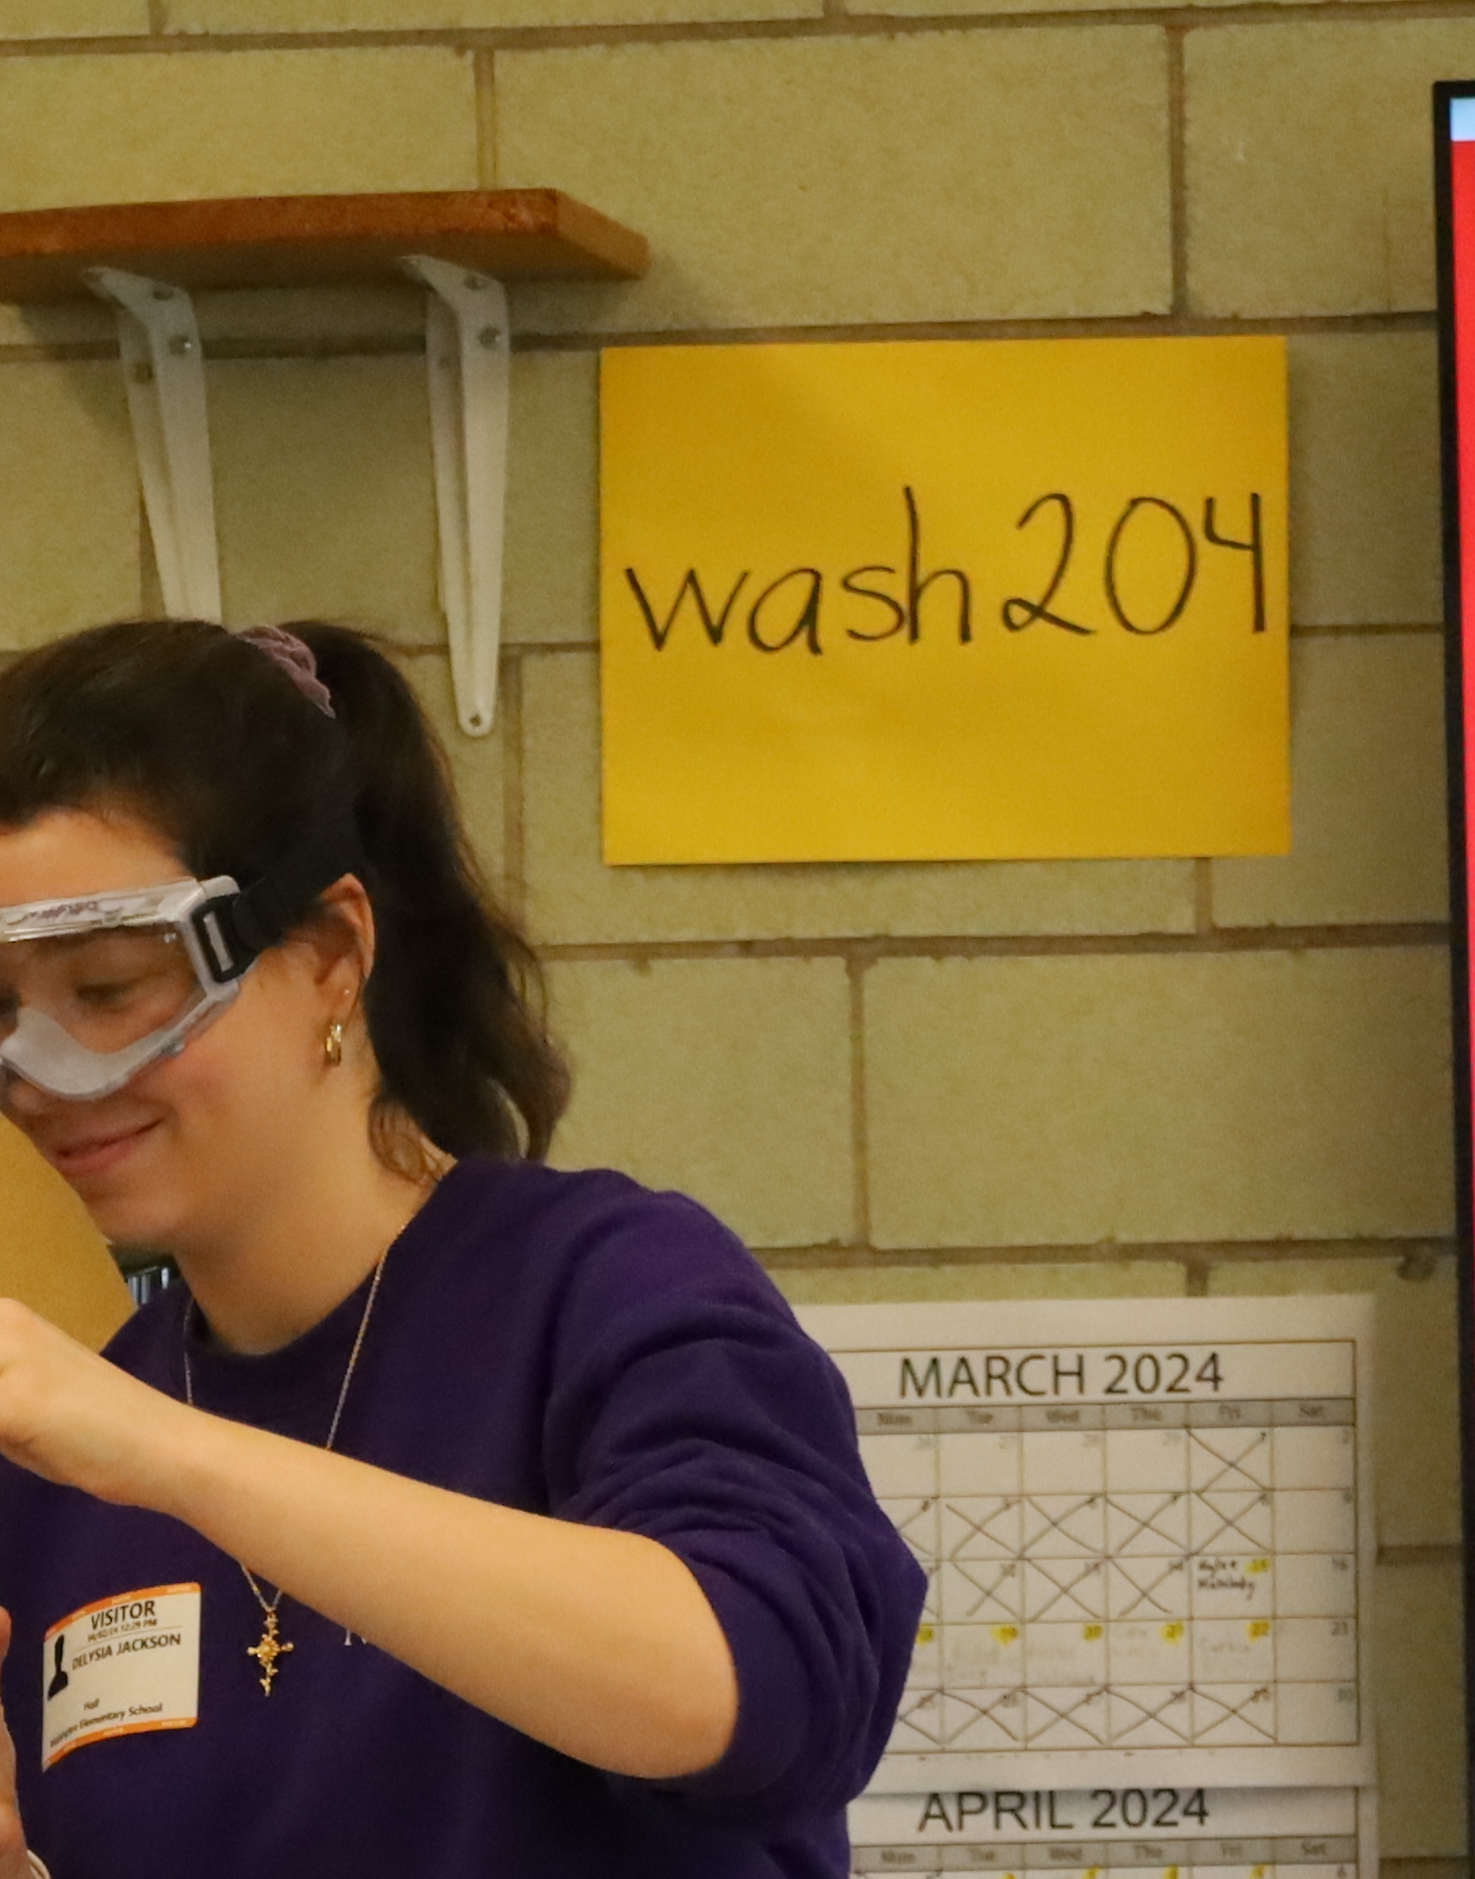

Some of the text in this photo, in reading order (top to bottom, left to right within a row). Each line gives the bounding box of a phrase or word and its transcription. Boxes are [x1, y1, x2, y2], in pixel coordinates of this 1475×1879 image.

[898, 1349, 1225, 1400] MARCH 2024
[91, 1599, 156, 1631] VISITOR
[116, 1633, 181, 1656] JACKSON
[917, 1787, 1209, 1832] APRIL 2024
